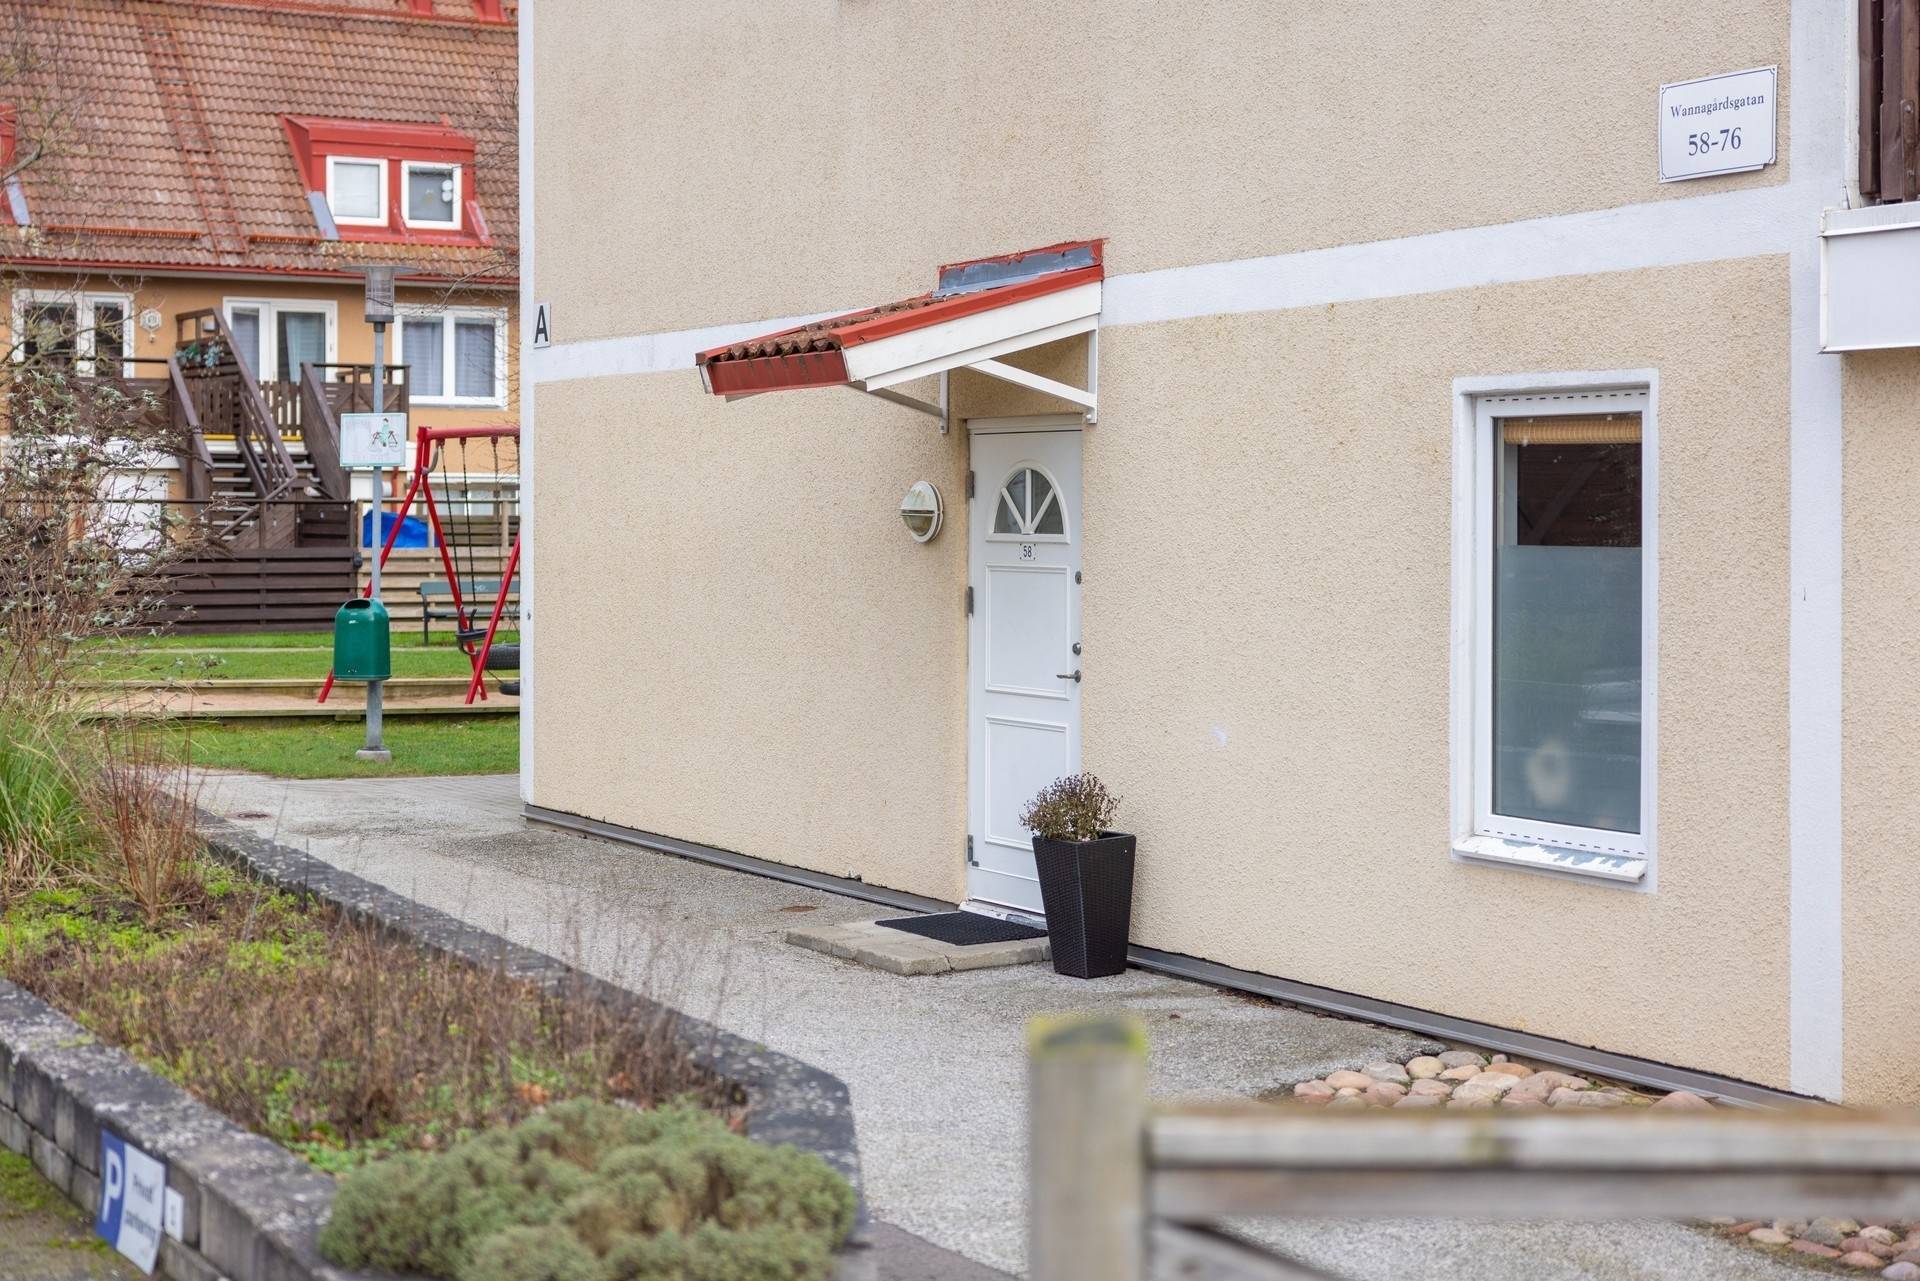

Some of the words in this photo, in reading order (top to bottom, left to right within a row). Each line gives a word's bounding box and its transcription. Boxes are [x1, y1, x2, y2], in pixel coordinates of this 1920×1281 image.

[1670, 94, 1765, 118] Wannagårdsgatan
[1688, 127, 1742, 156] 58-76
[534, 304, 549, 344] A
[1023, 545, 1032, 558] 58
[103, 1148, 122, 1222] P
